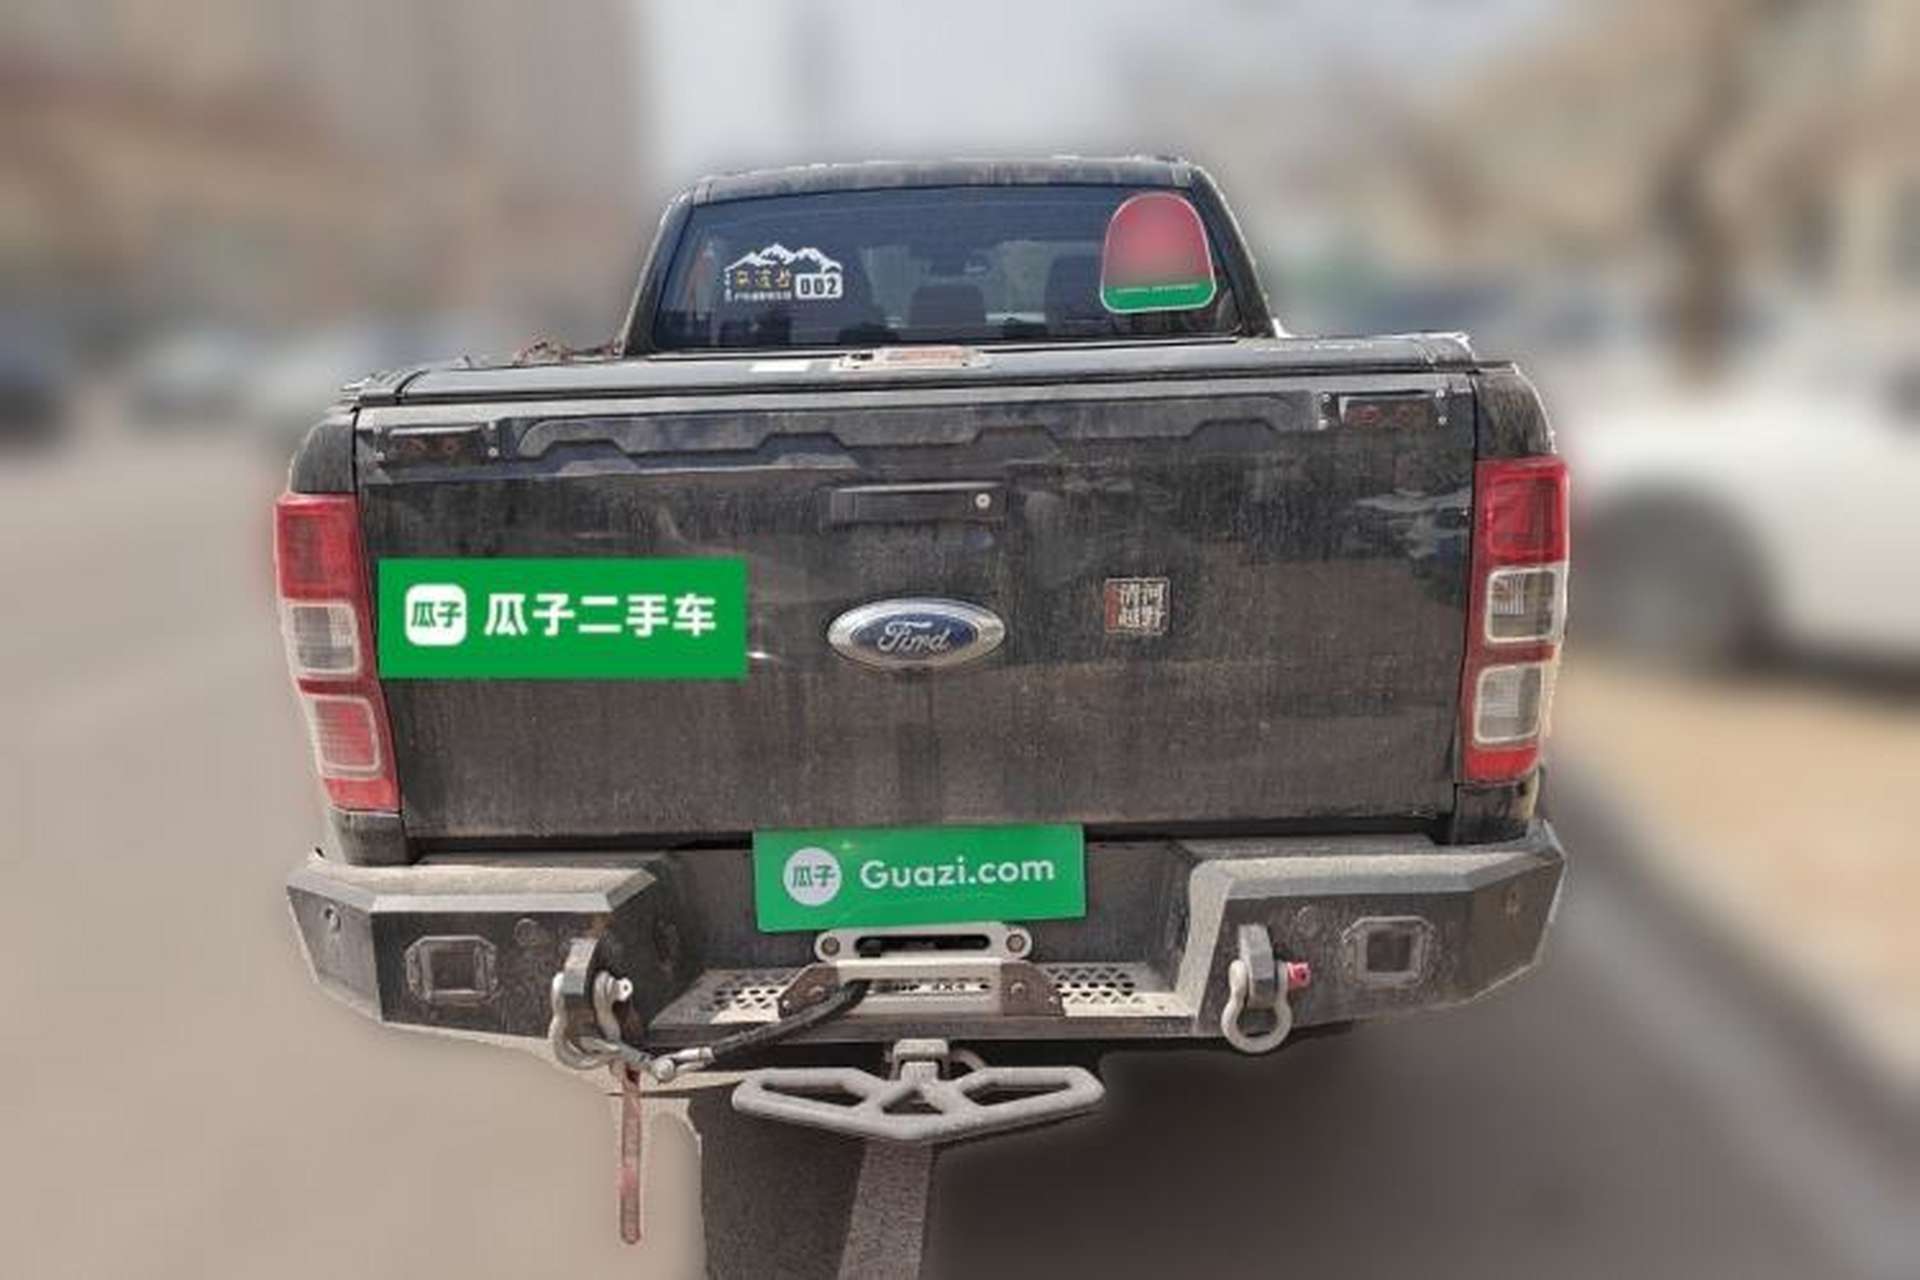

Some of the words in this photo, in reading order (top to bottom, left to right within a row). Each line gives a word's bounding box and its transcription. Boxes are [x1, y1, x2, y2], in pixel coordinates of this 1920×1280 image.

[800, 277, 838, 295] 002
[877, 621, 951, 651] Ford
[791, 864, 836, 888] 瓜子
[860, 856, 1054, 889] Guazi.com
